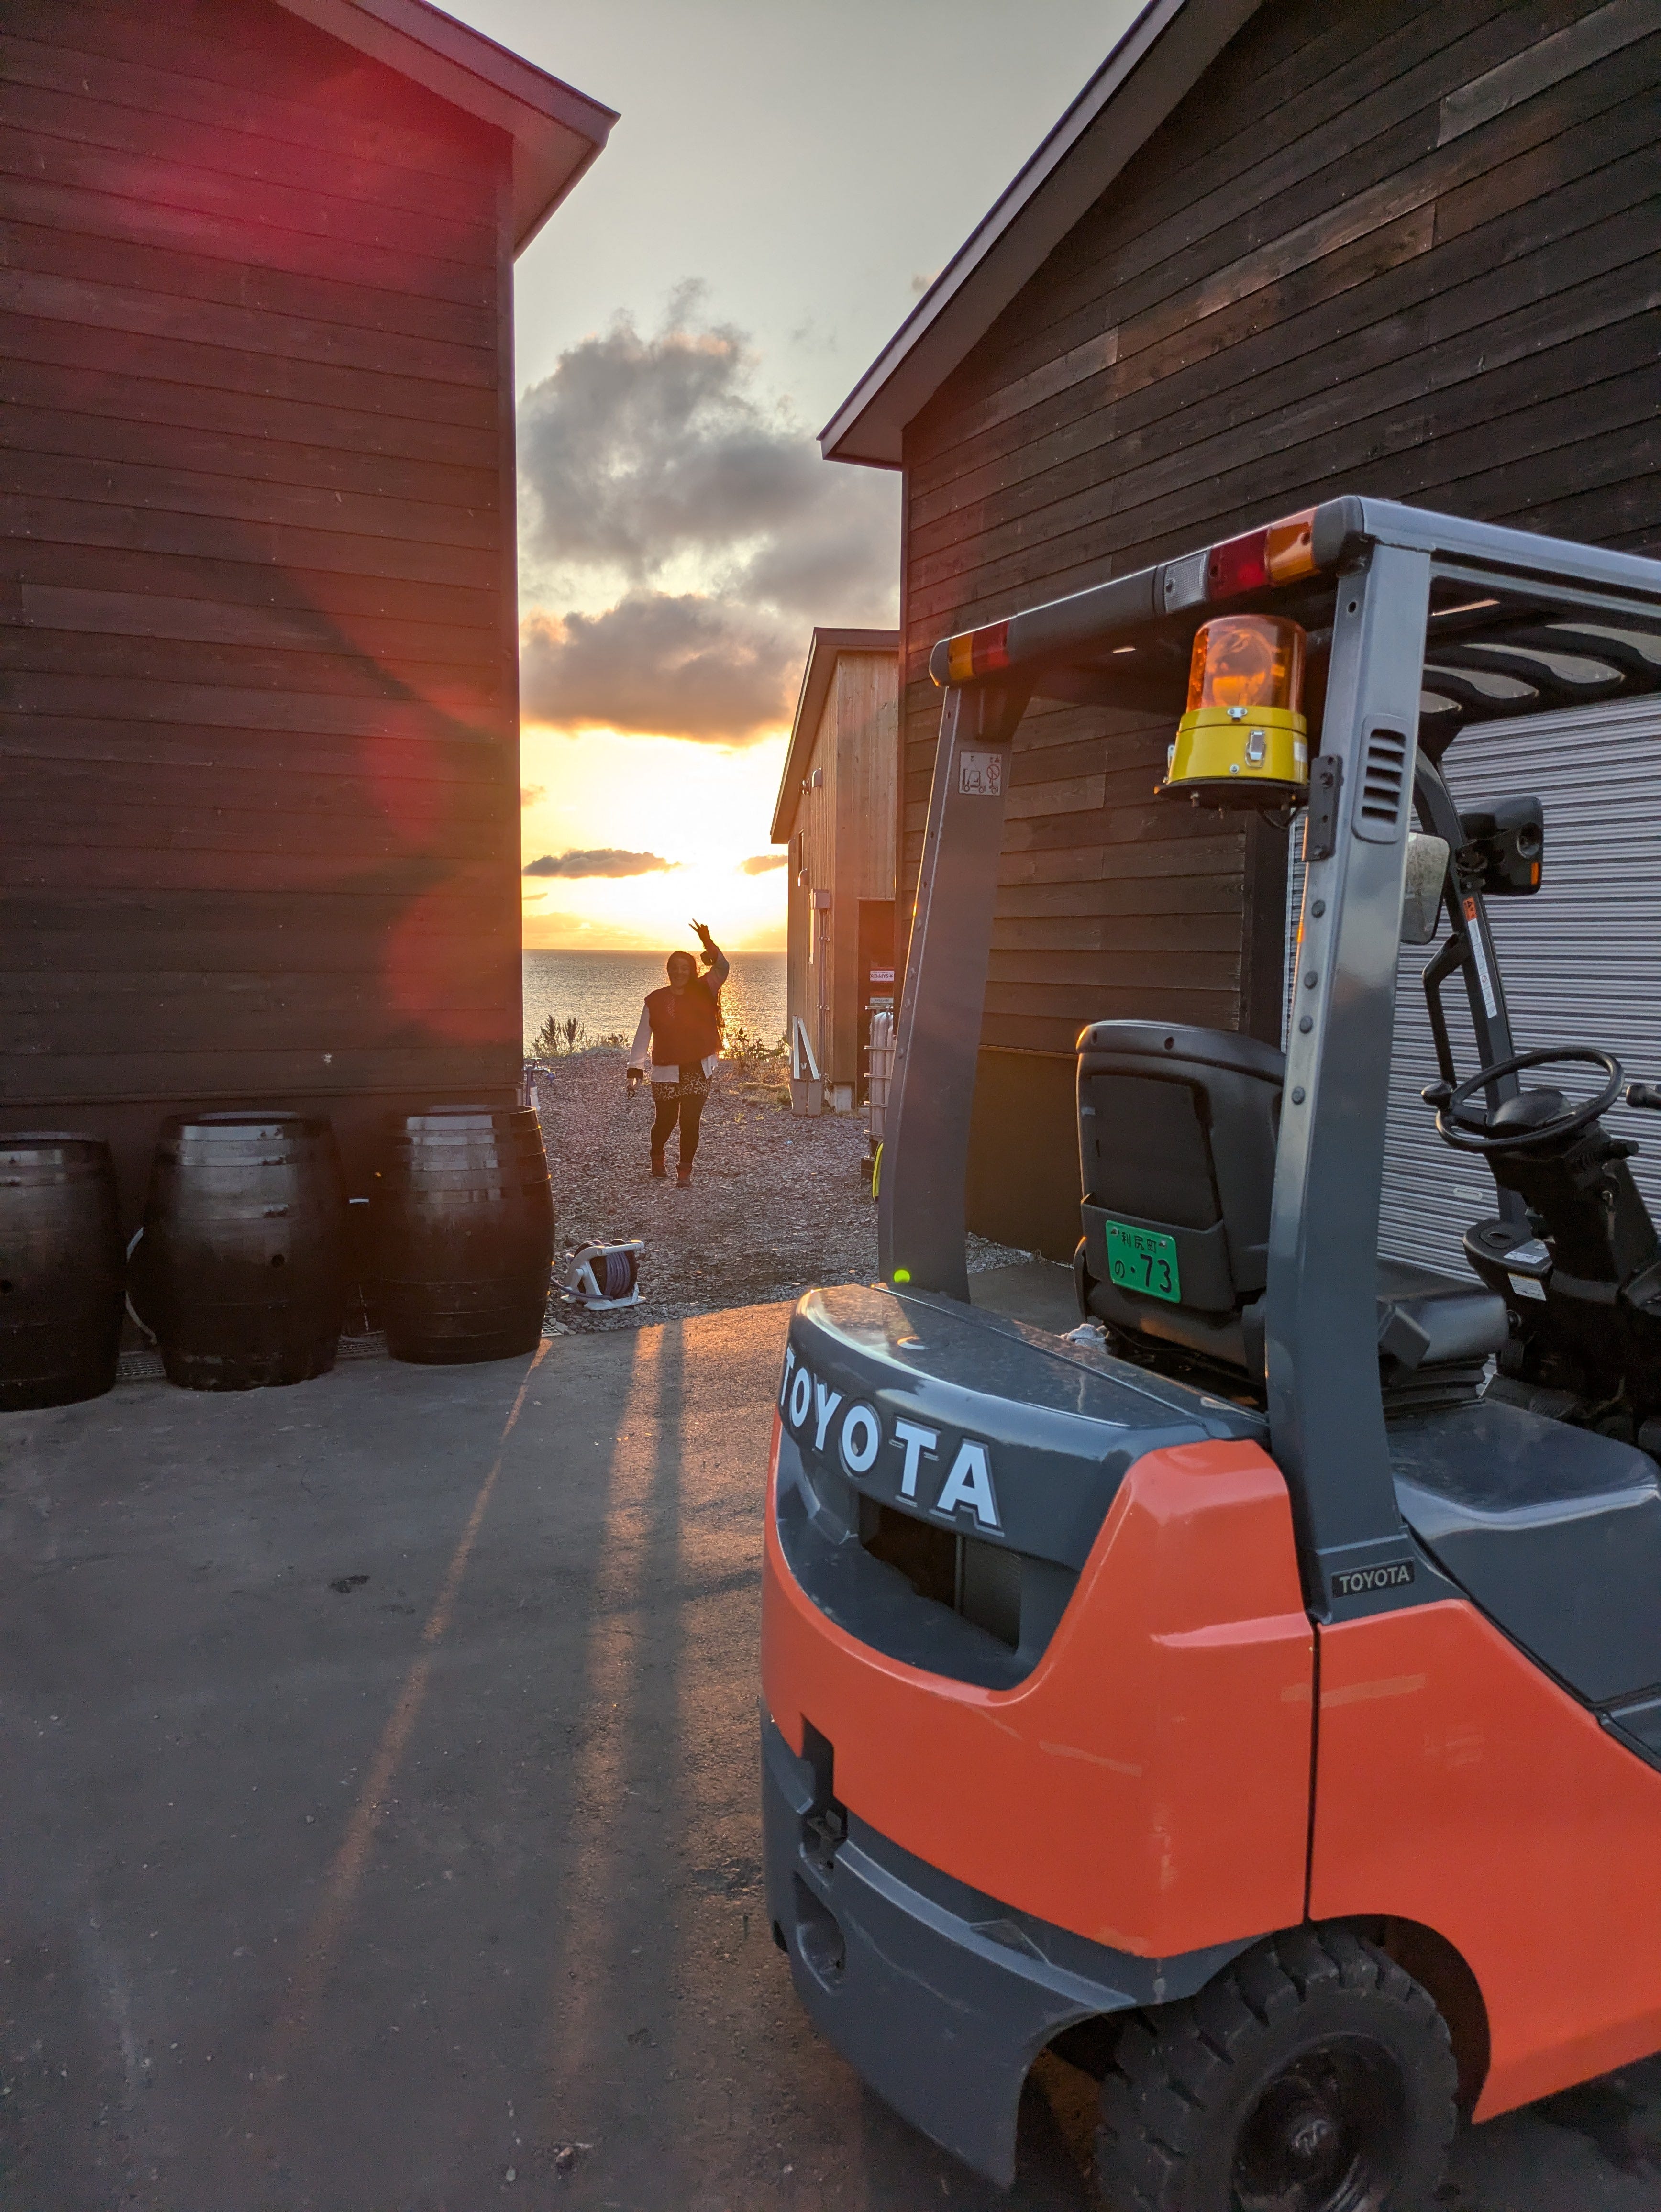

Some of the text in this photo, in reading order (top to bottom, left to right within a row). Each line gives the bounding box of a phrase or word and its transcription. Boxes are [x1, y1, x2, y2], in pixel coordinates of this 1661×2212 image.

[1122, 1232, 1157, 1253] 利尻町
[781, 1344, 999, 1526] TOYOTA
[1340, 1565, 1410, 1593] TOYOTA
